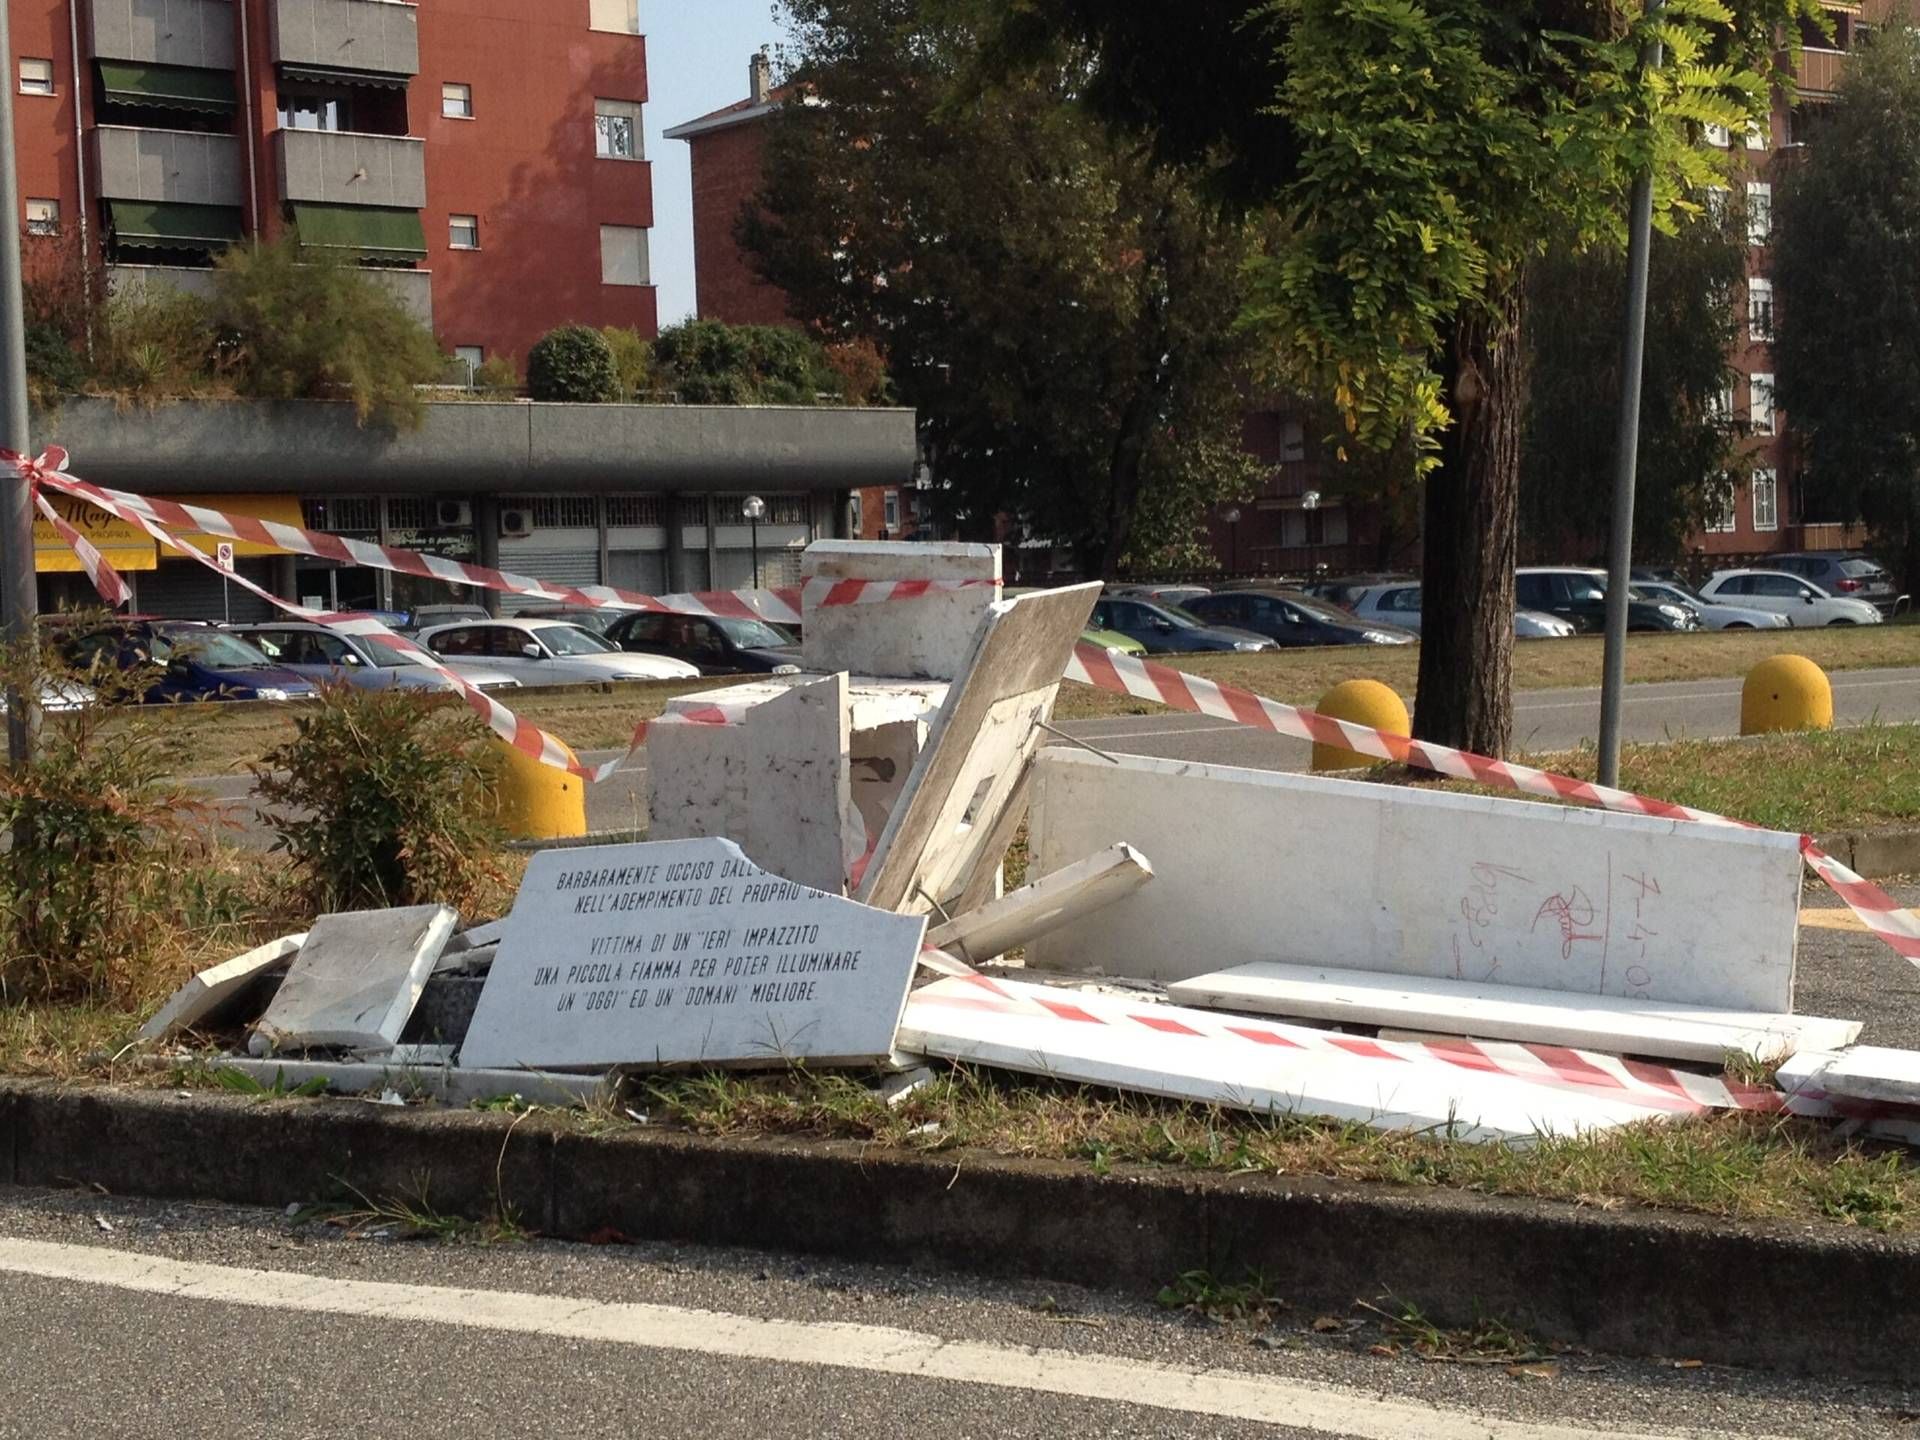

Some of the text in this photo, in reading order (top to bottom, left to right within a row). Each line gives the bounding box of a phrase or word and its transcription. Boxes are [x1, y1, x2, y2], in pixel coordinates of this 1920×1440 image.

[556, 865, 660, 890] BARBARAMENTE
[666, 861, 714, 882] UCCISO
[574, 888, 702, 914] NELL'ADEMPIMENTO
[709, 886, 733, 905] DEL
[742, 882, 801, 903] PROPRIO
[590, 935, 643, 955] VITTIMA
[651, 933, 667, 953] DI
[672, 932, 692, 952] UN
[743, 925, 819, 947] IMPAZZITO
[534, 950, 862, 986] UNA PICCOLA FIAMMA PER POTER ILLUMINARE
[557, 992, 577, 1012] UN
[629, 989, 649, 1008] ED
[655, 988, 674, 1007] UN
